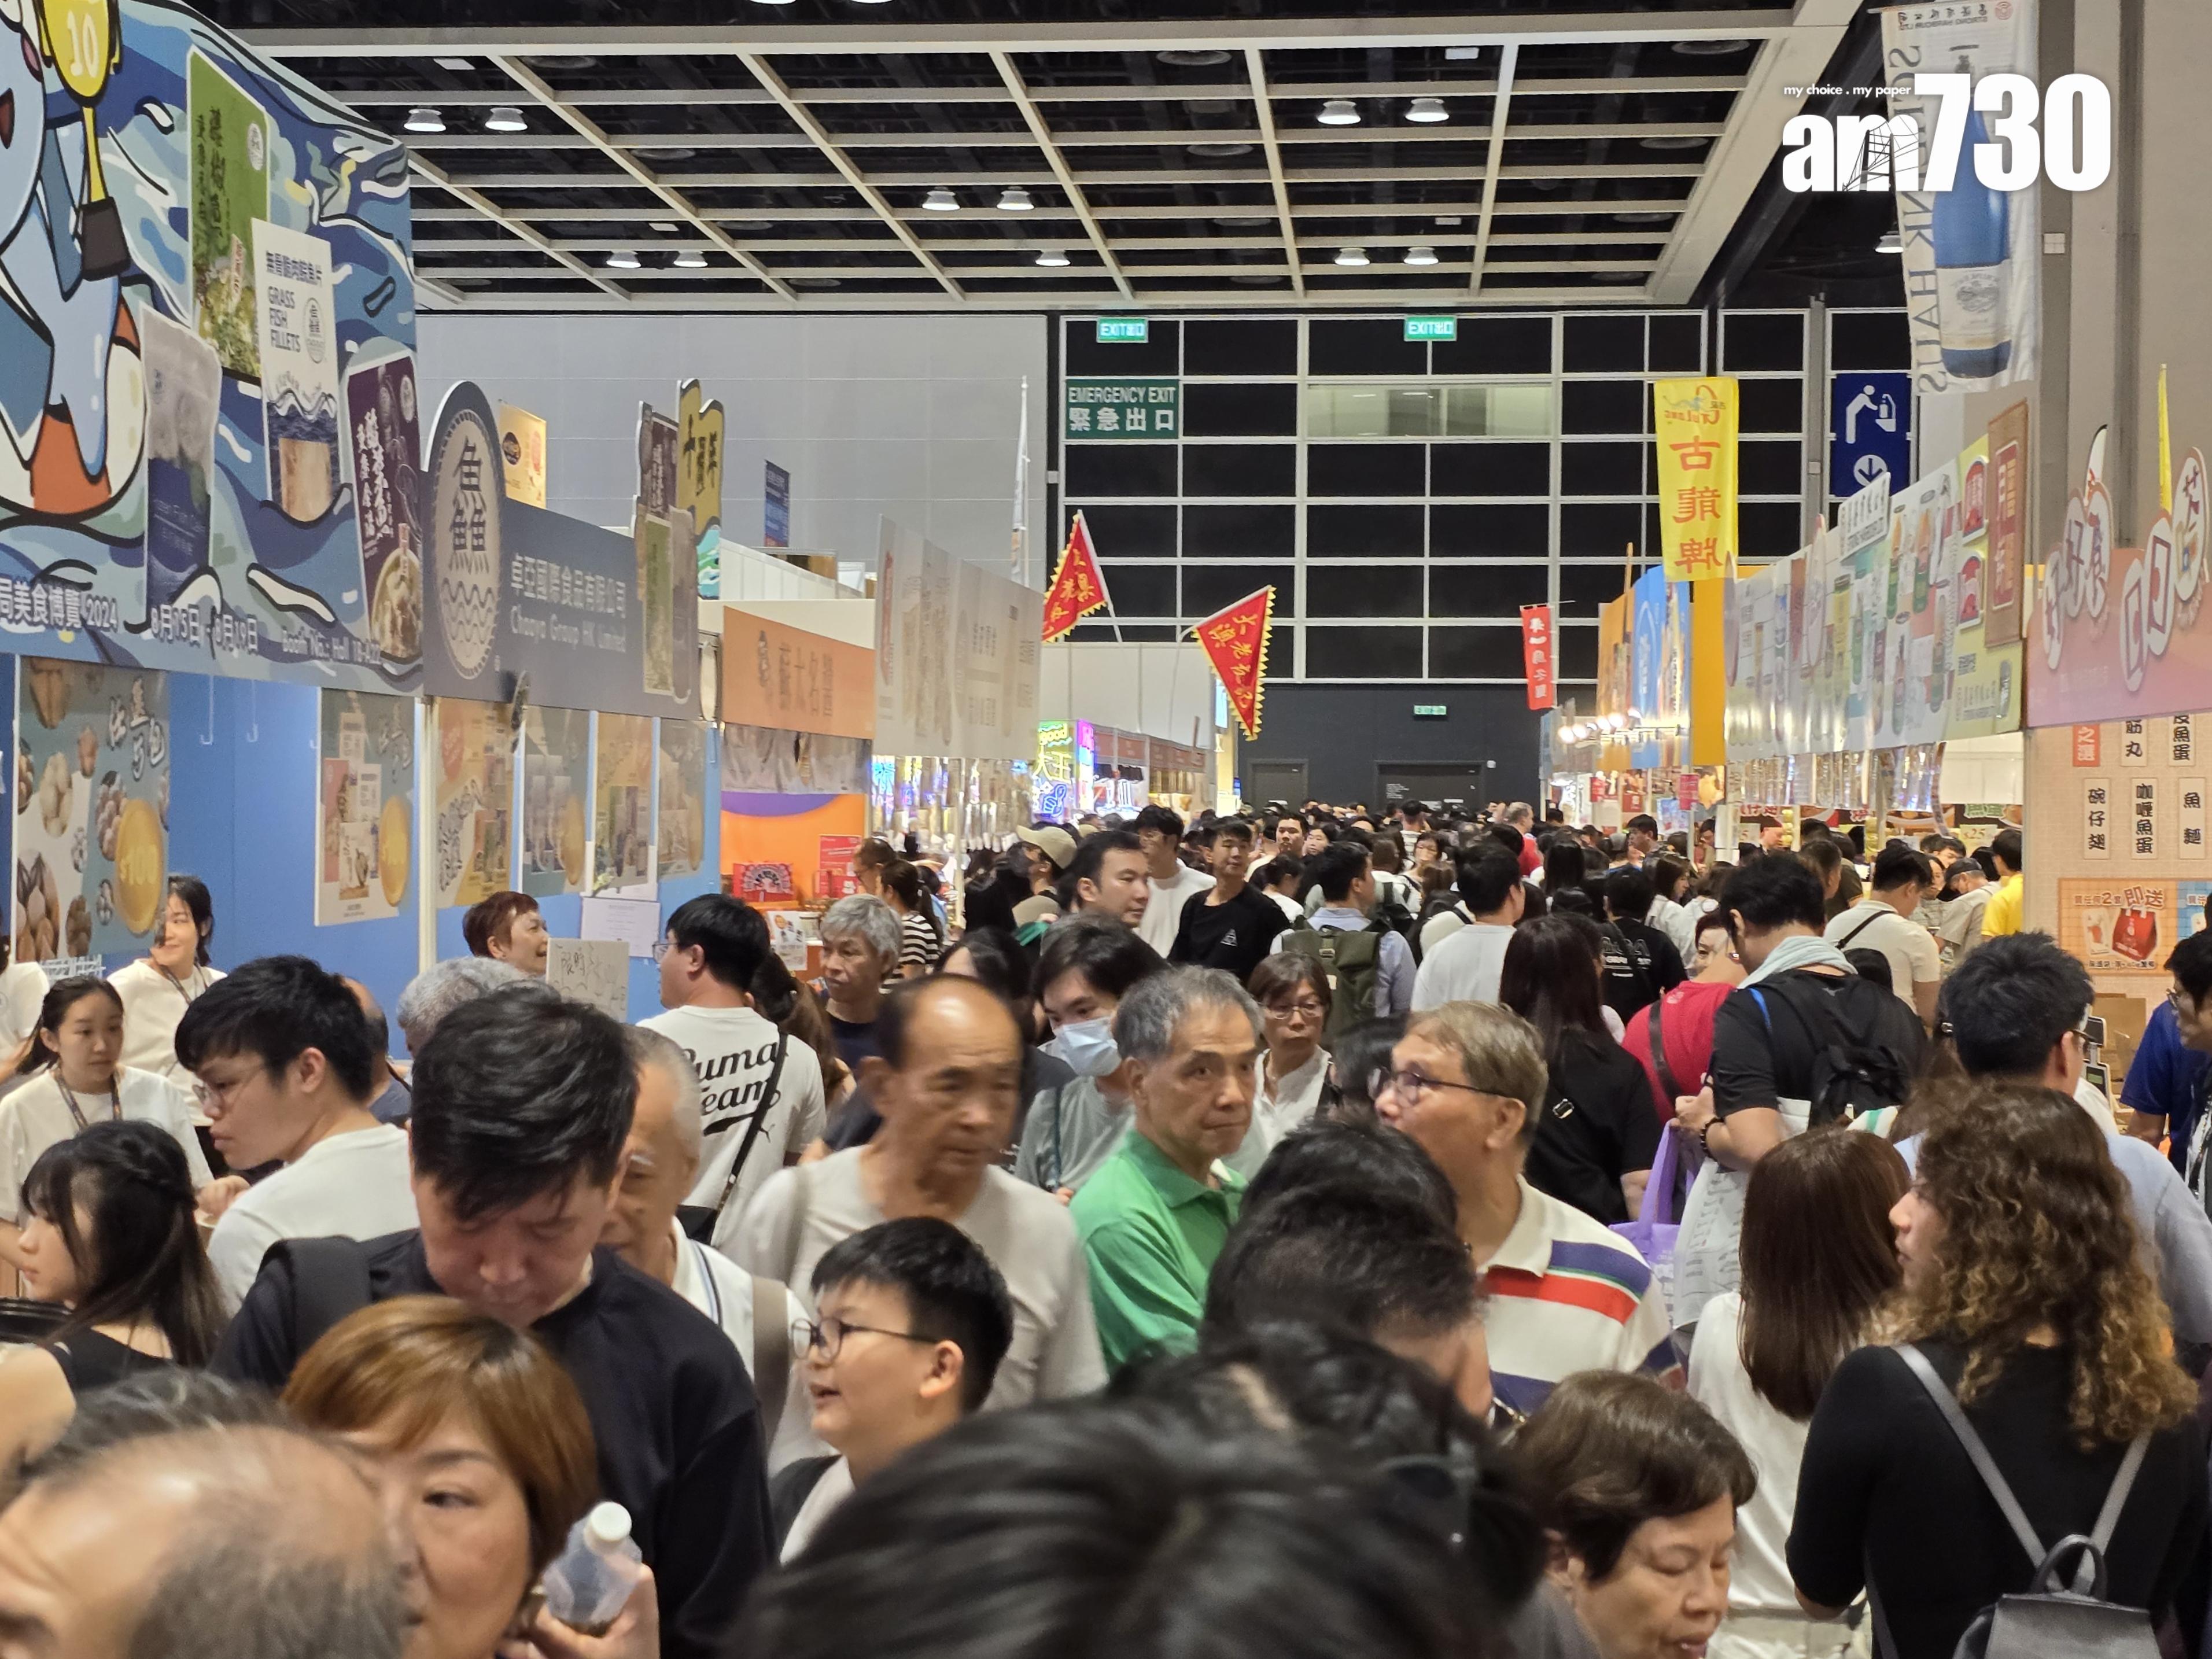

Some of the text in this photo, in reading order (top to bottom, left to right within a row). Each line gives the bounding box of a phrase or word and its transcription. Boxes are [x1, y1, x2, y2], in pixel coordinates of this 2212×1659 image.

[67, 10, 99, 79] 10
[1068, 386, 1176, 403] EMERGENCY EXIT
[1069, 407, 1174, 431] 緊急出口
[86, 595, 118, 631] 2024
[2124, 886, 2165, 909] 即送
